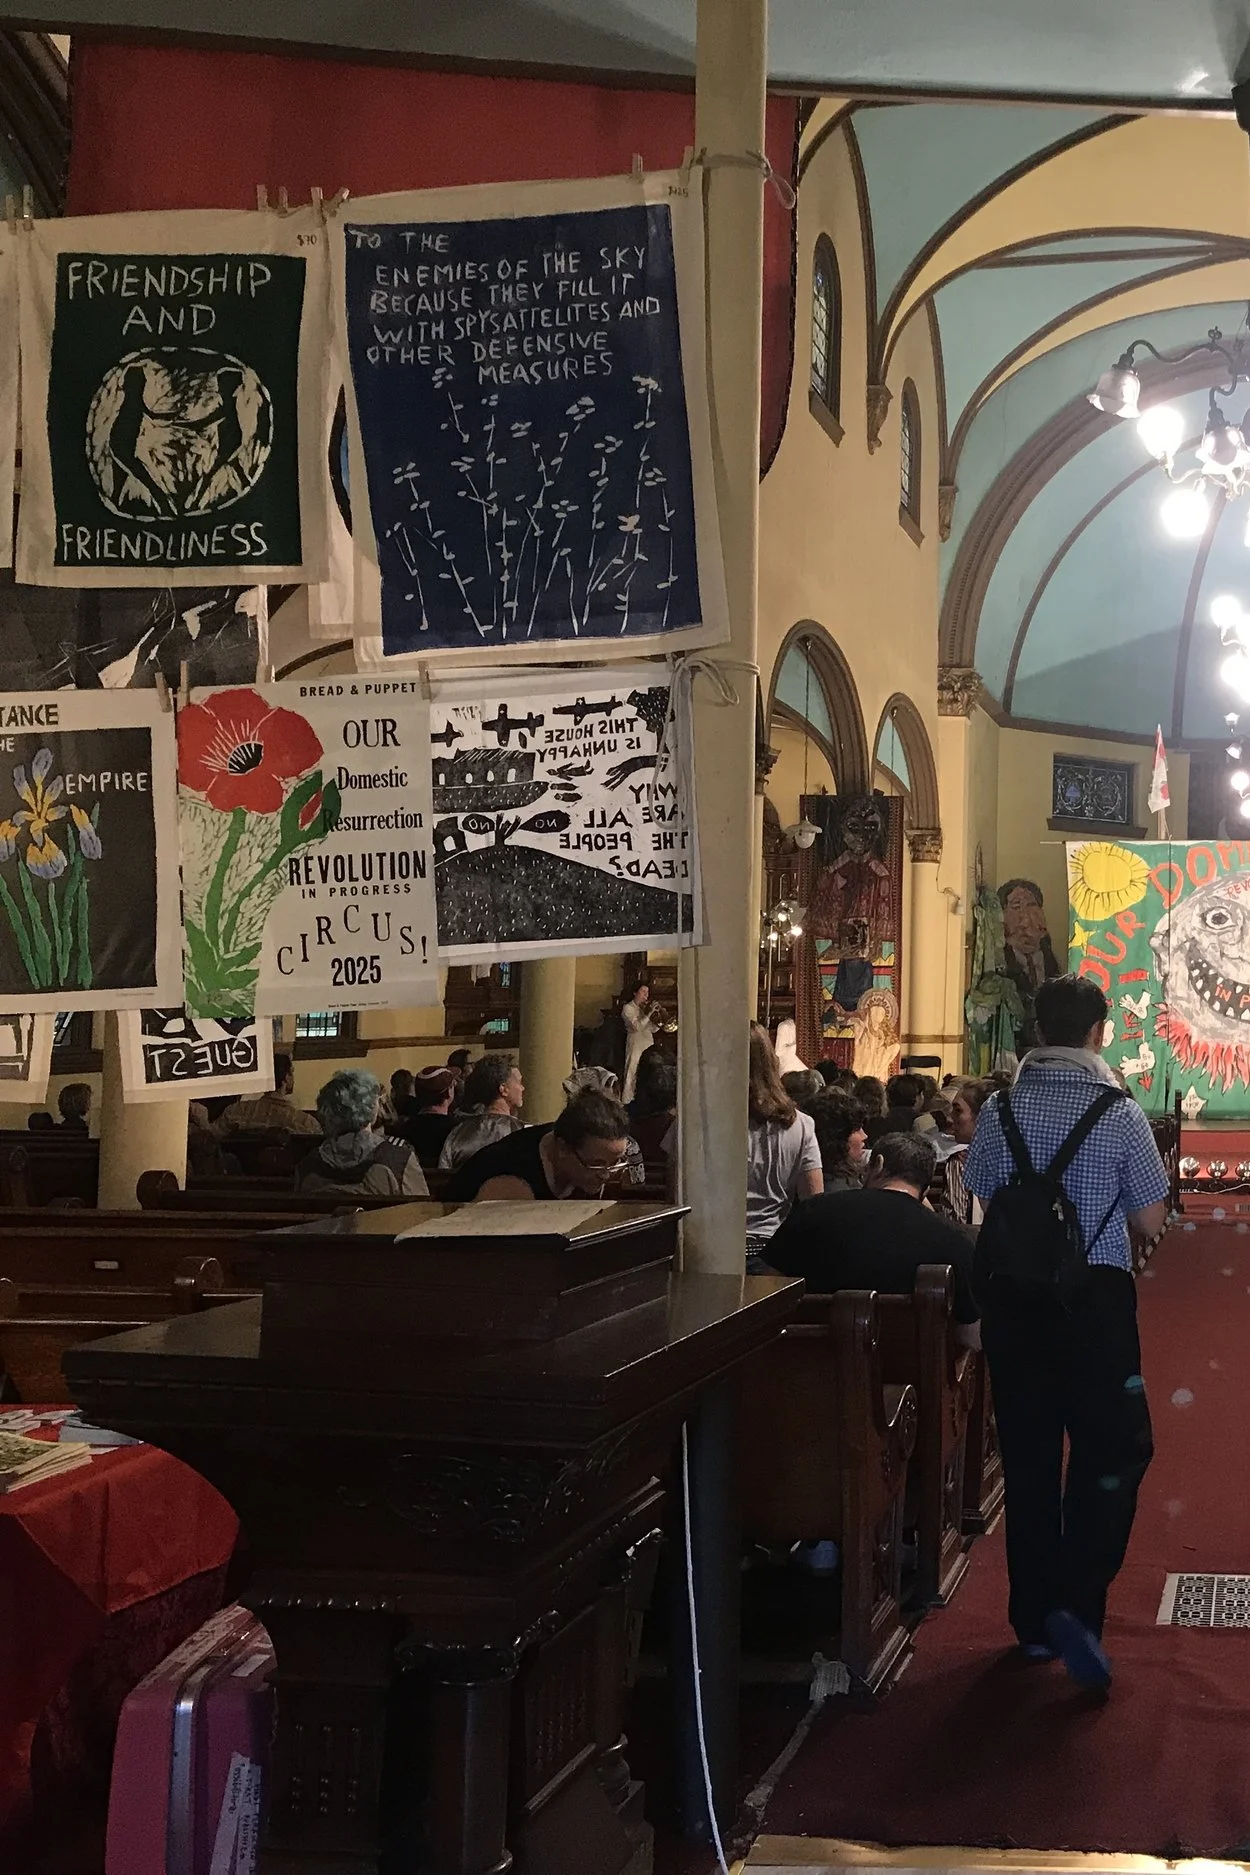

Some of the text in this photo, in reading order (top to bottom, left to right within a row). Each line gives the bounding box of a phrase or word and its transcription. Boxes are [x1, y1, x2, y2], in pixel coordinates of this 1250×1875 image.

[351, 230, 450, 253] TO THE
[68, 260, 272, 300] FRIENDSHIP
[376, 245, 646, 288] ENEMIES OF THE SKY
[370, 273, 635, 316] BECAUSE THEY FILL IT
[122, 304, 216, 336] AND
[374, 319, 444, 345] WITH
[619, 296, 661, 321] AND
[366, 331, 609, 366] OTHER DEFENSIVE
[478, 352, 614, 386] MEASURES
[61, 522, 269, 561] FRIENDLINESS
[300, 682, 417, 698] BREAD & PUPPET
[343, 718, 401, 748] OUR
[65, 771, 148, 795] EMPIRE
[337, 765, 409, 791] Domestic
[322, 806, 424, 833] Resurrection
[288, 850, 427, 886] REVOLUTION
[302, 883, 412, 899] IN PROGRESS
[276, 904, 429, 976] CIRCUS!
[1077, 911, 1146, 993] OUR
[331, 955, 382, 987] 2025
